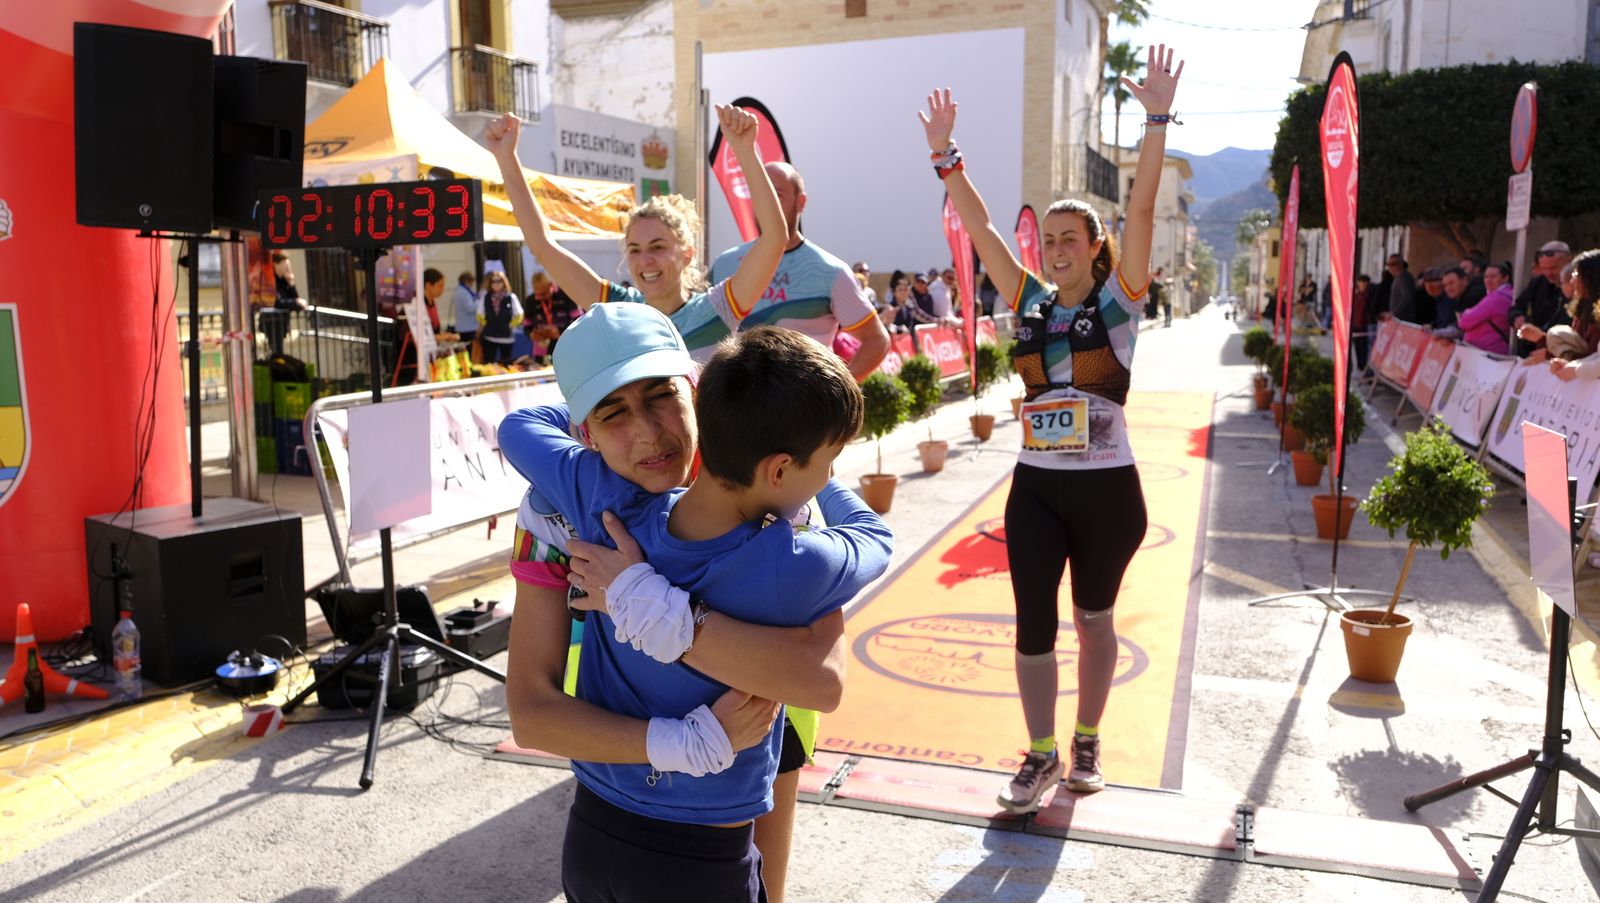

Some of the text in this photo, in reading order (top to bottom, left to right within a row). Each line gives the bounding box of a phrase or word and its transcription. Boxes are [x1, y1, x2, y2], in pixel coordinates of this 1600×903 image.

[561, 130, 636, 158] EXCELENTÍSIMO
[563, 158, 635, 183] AYUNTAMIENTO
[268, 184, 469, 244] 02:10:33
[1031, 410, 1073, 430] 370
[824, 737, 983, 767] Cantoria
